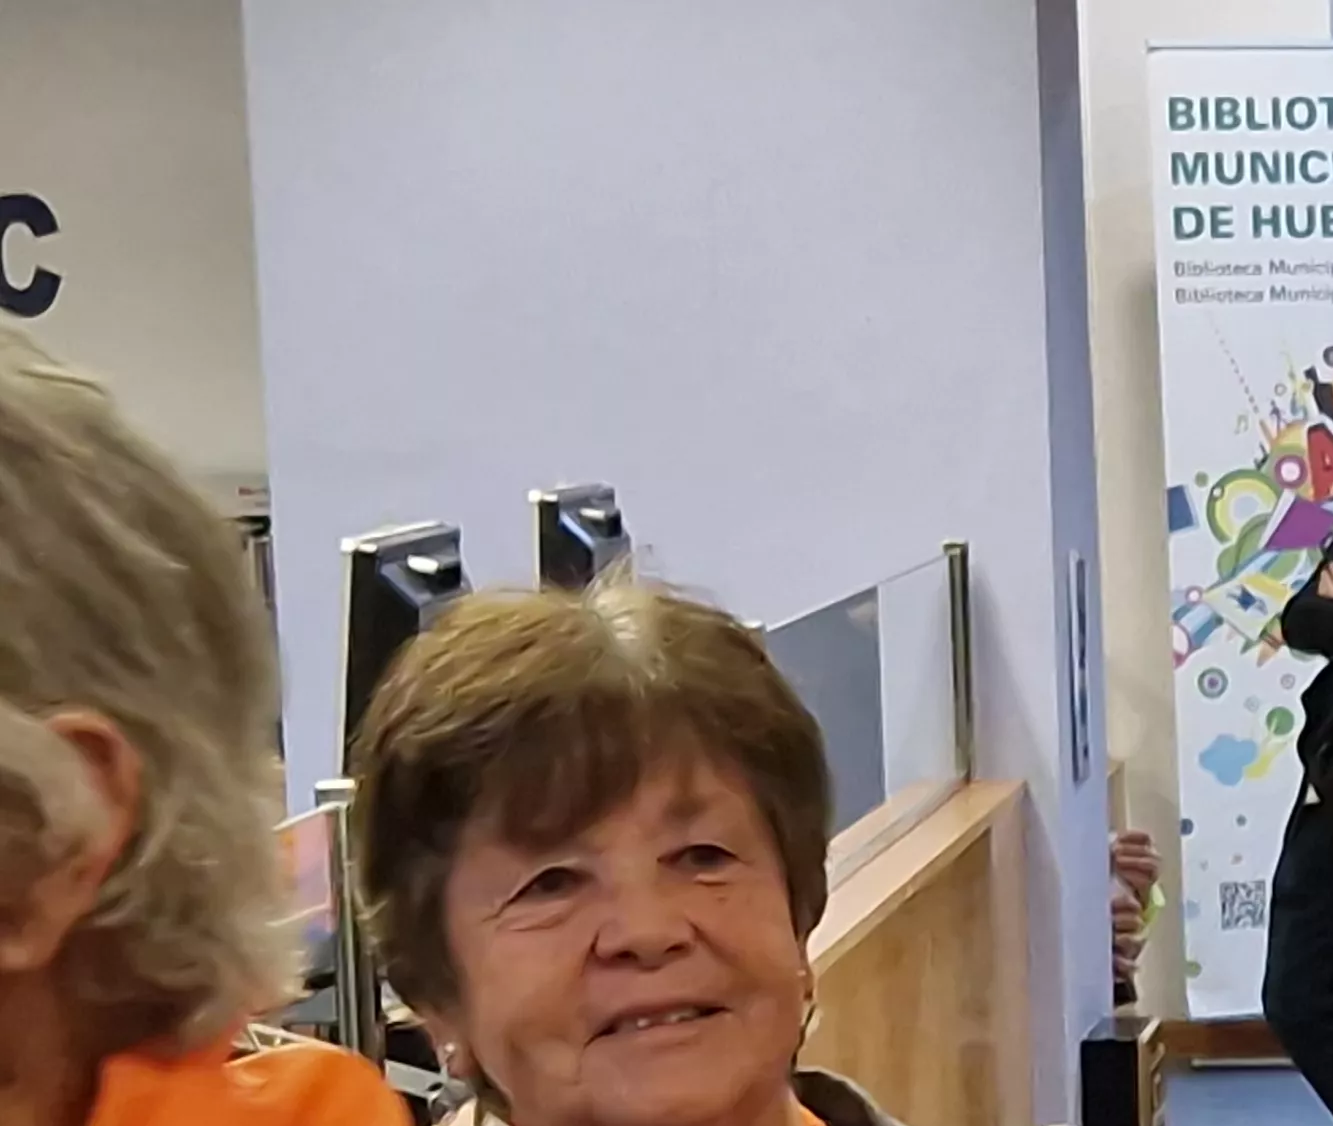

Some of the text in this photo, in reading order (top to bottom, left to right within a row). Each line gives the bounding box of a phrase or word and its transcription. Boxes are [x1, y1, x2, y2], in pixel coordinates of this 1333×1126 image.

[1173, 206, 1234, 240] DE
[1174, 260, 1262, 277] Biblioteca
[1175, 287, 1264, 304] Biblioteca
